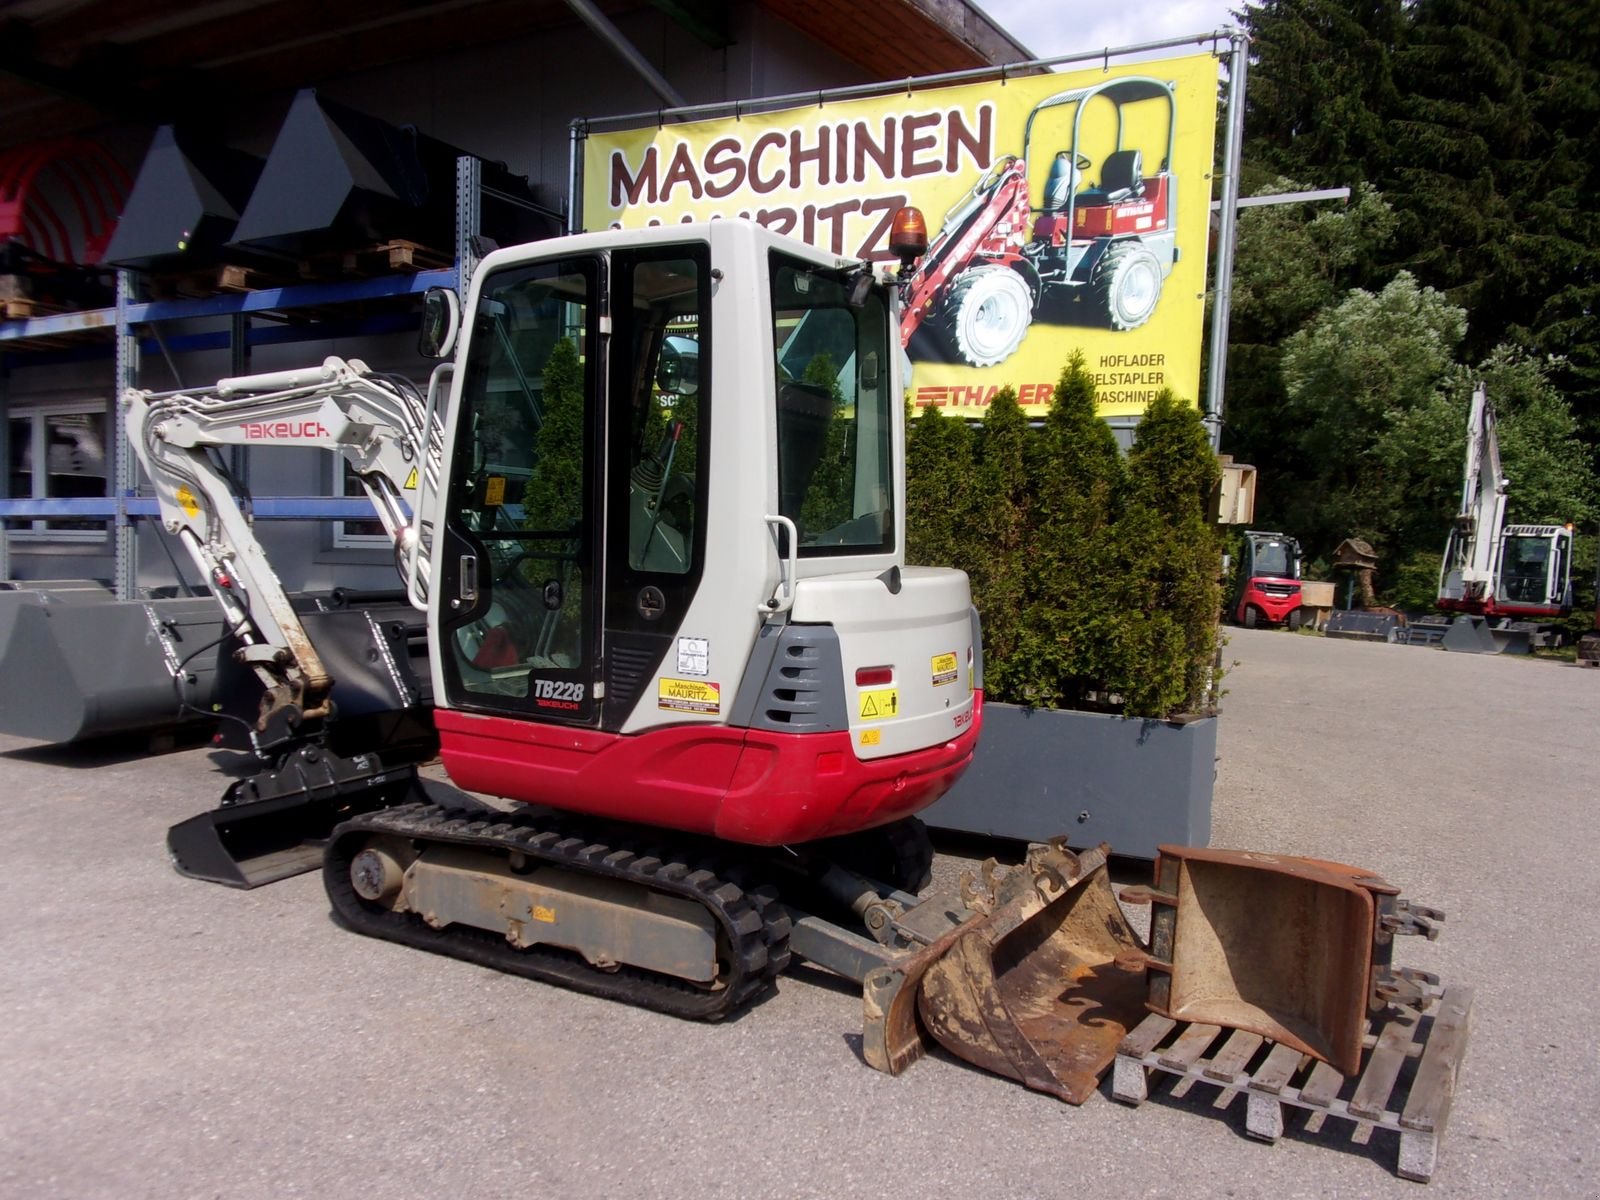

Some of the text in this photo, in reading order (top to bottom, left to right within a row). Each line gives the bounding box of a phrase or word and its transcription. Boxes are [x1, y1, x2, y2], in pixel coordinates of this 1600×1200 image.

[610, 105, 992, 207] MASCHINEN
[1099, 353, 1165, 368] HOFLADER
[948, 383, 1055, 406] THAER
[239, 422, 331, 439] TAKEUCH
[535, 679, 585, 702] TB228
[668, 688, 708, 701] MAURITZ
[536, 699, 580, 711] TAKEUCHI
